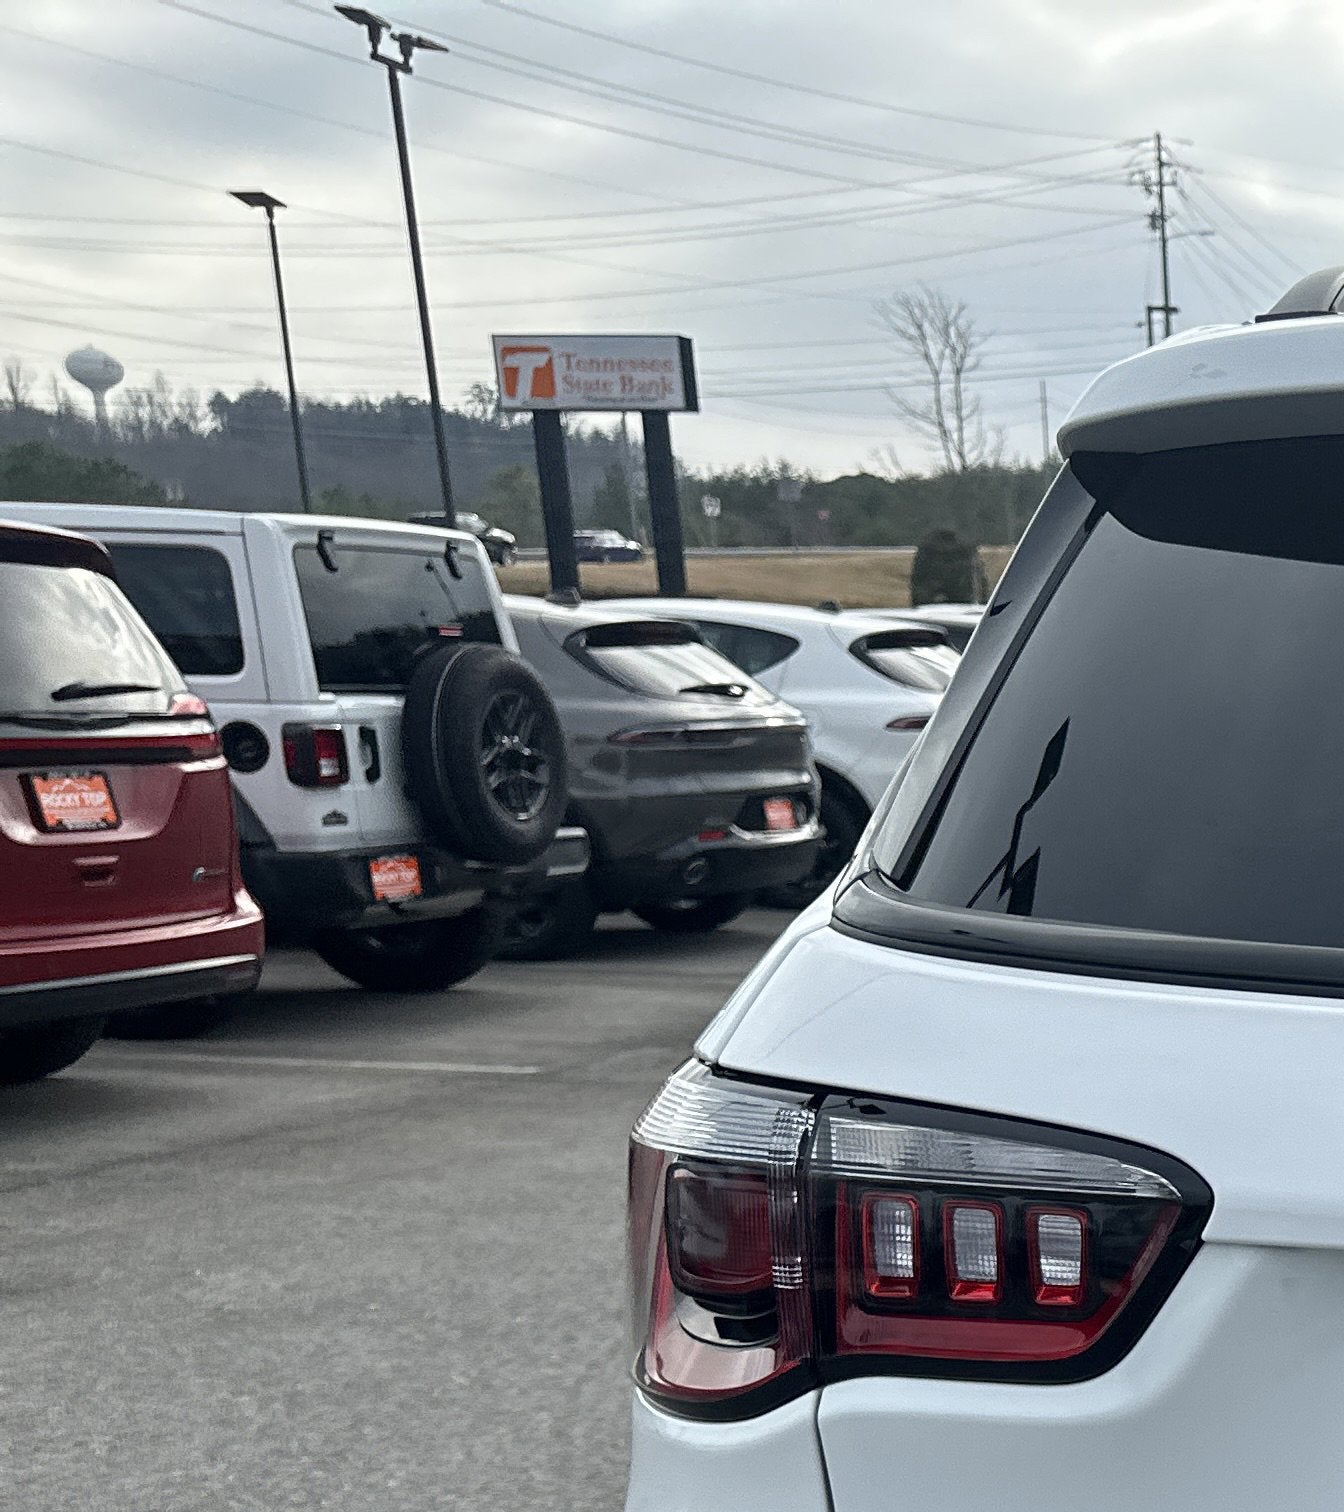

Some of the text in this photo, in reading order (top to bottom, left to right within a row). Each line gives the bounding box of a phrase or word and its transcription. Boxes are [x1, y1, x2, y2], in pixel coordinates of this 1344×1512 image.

[559, 352, 675, 372] Tennessee
[561, 374, 675, 396] State Bank
